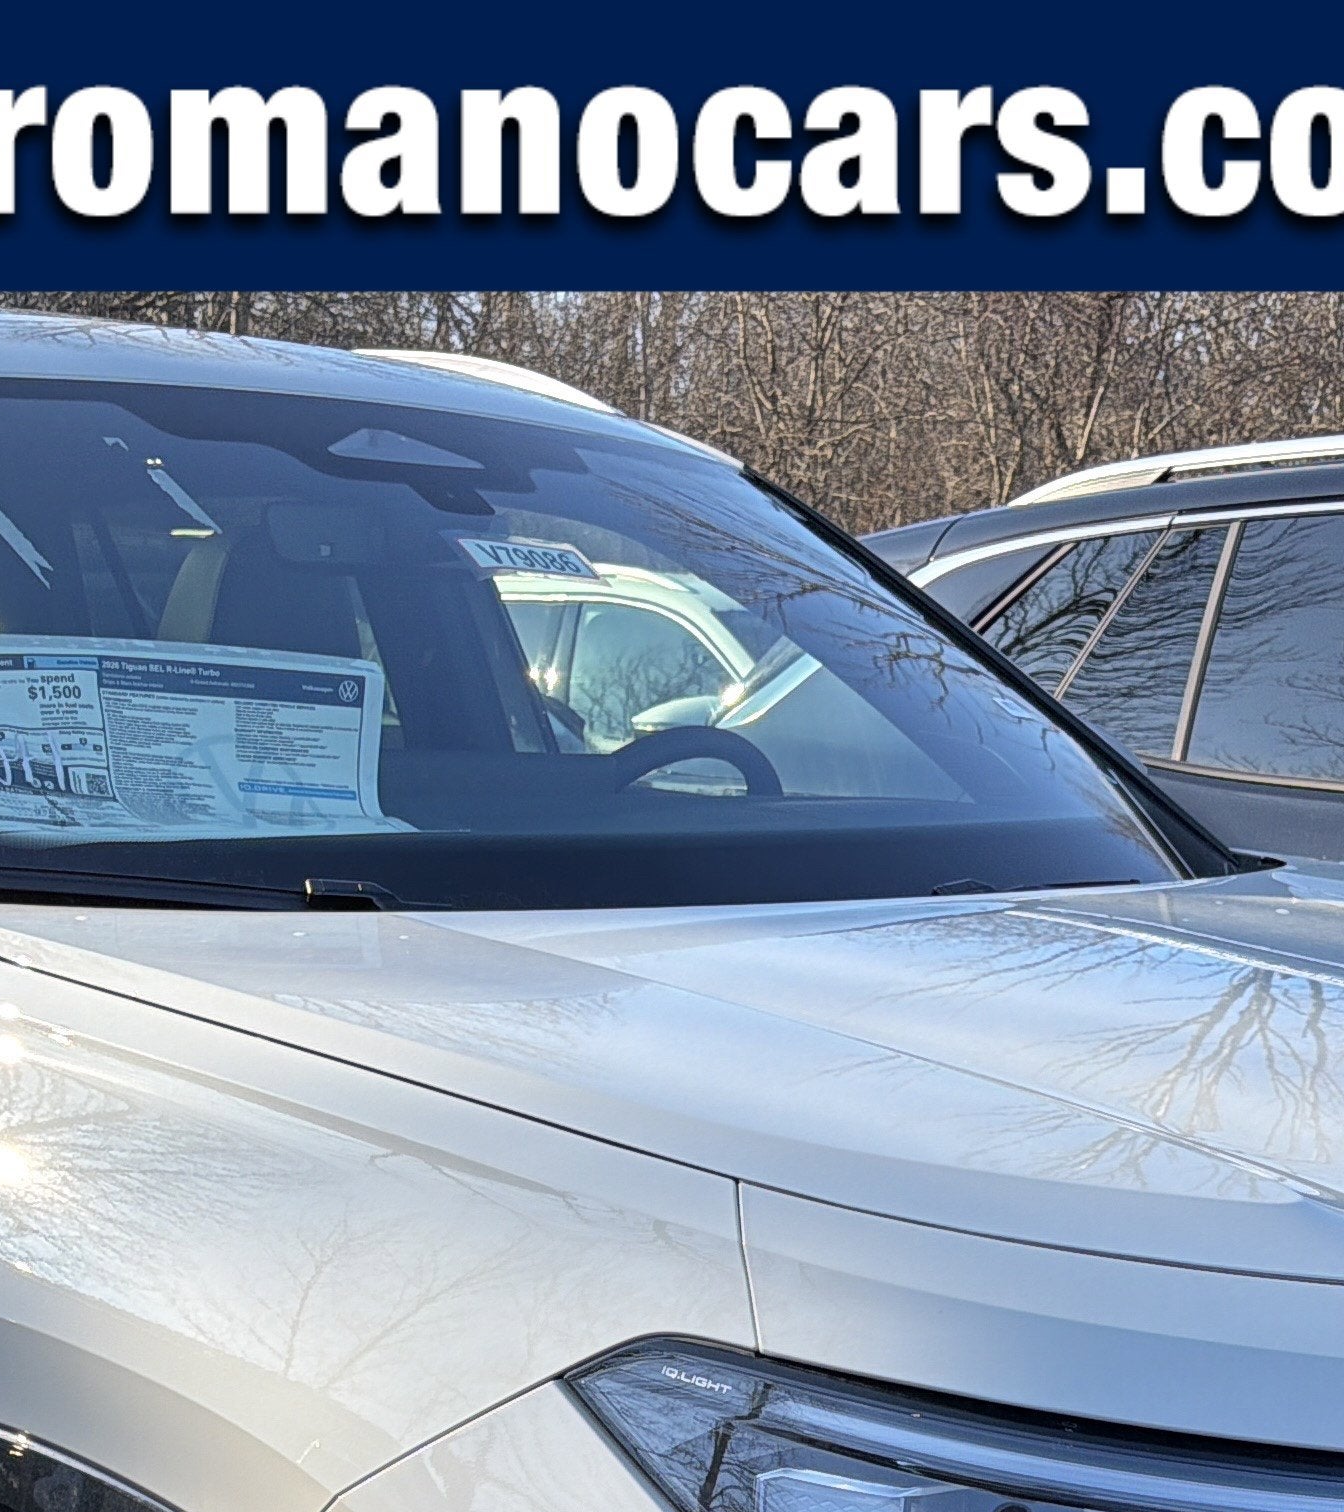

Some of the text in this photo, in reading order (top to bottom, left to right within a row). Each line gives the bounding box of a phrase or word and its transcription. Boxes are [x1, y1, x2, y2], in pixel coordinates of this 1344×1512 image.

[475, 543, 582, 574] V79086
[120, 661, 148, 673] Tiguan
[197, 667, 221, 678] Turbo
[40, 673, 76, 686] spend
[27, 685, 82, 702] $1,500
[661, 1365, 733, 1395] IQ.LIGHT
